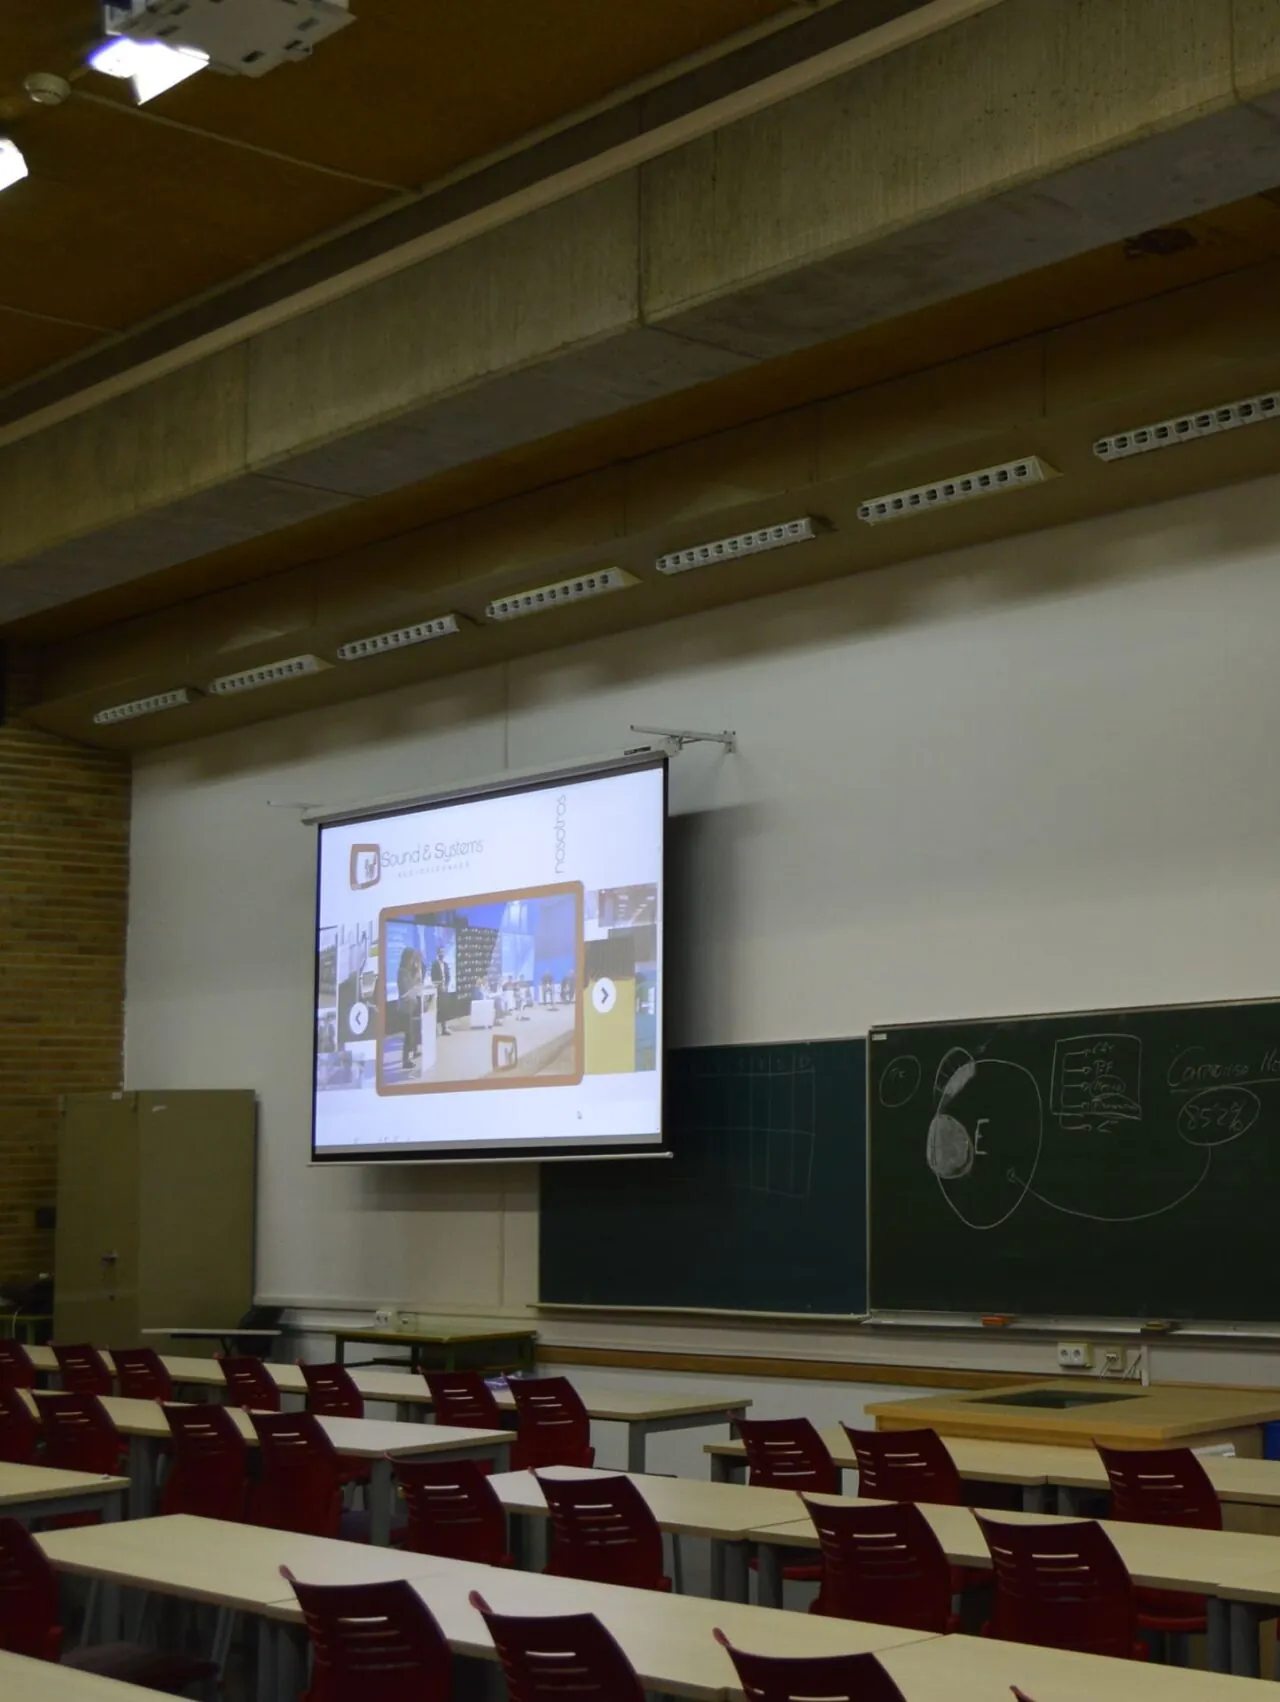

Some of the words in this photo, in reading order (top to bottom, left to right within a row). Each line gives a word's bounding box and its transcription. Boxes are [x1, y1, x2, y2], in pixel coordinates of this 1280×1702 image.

[381, 844, 421, 868] Sound
[422, 844, 432, 862] &
[434, 840, 485, 863] Systems
[553, 794, 566, 873] nosotros
